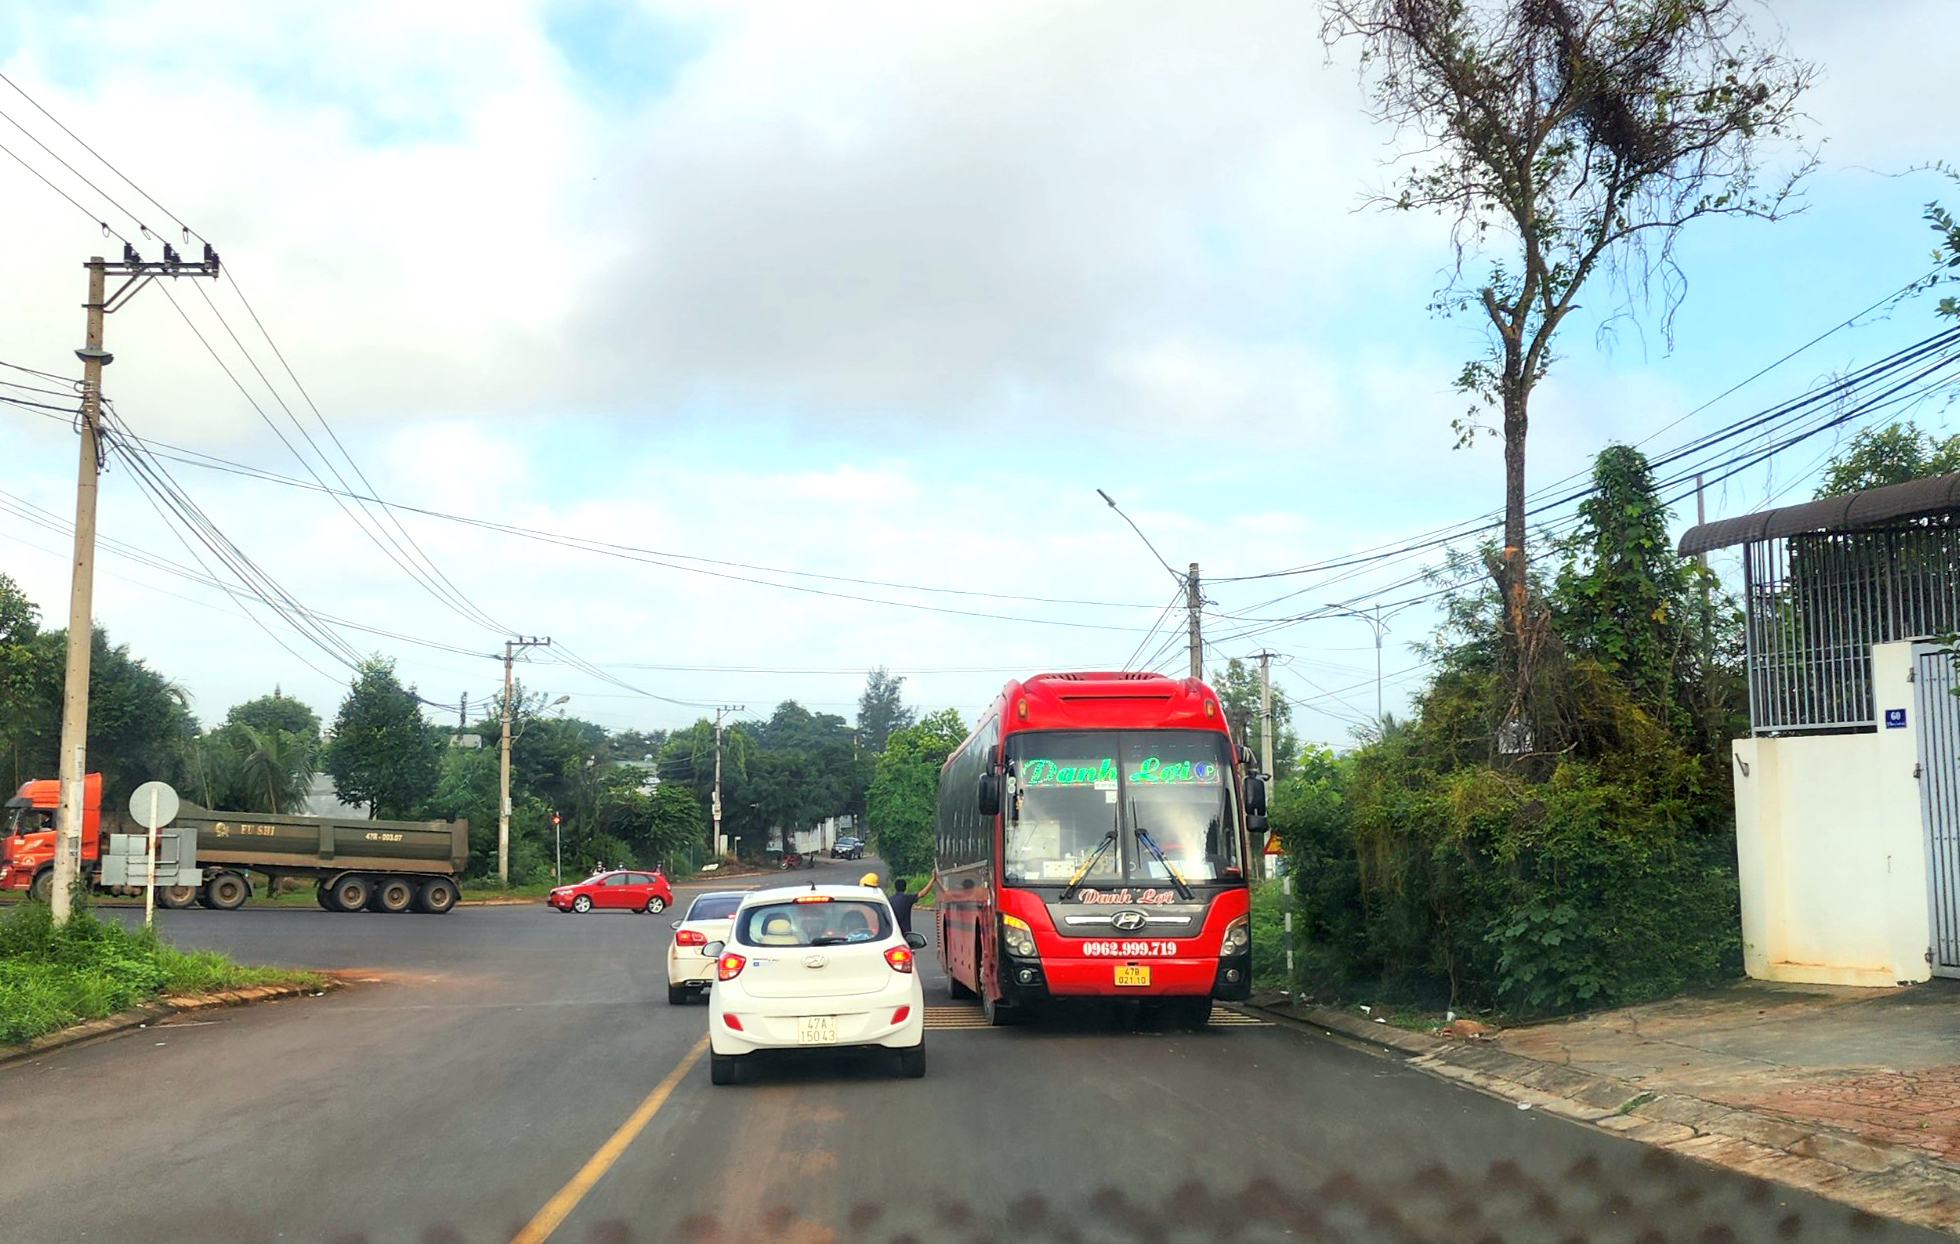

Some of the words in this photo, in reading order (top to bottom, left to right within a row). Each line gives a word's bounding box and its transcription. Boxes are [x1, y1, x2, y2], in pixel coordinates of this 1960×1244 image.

[1890, 711, 1901, 720] 60
[1021, 758, 1118, 784] Danh
[257, 825, 275, 836] SHI
[1079, 888, 1133, 905] Danh
[1083, 941, 1177, 956] 0962.999.719
[808, 1017, 828, 1029] 47A
